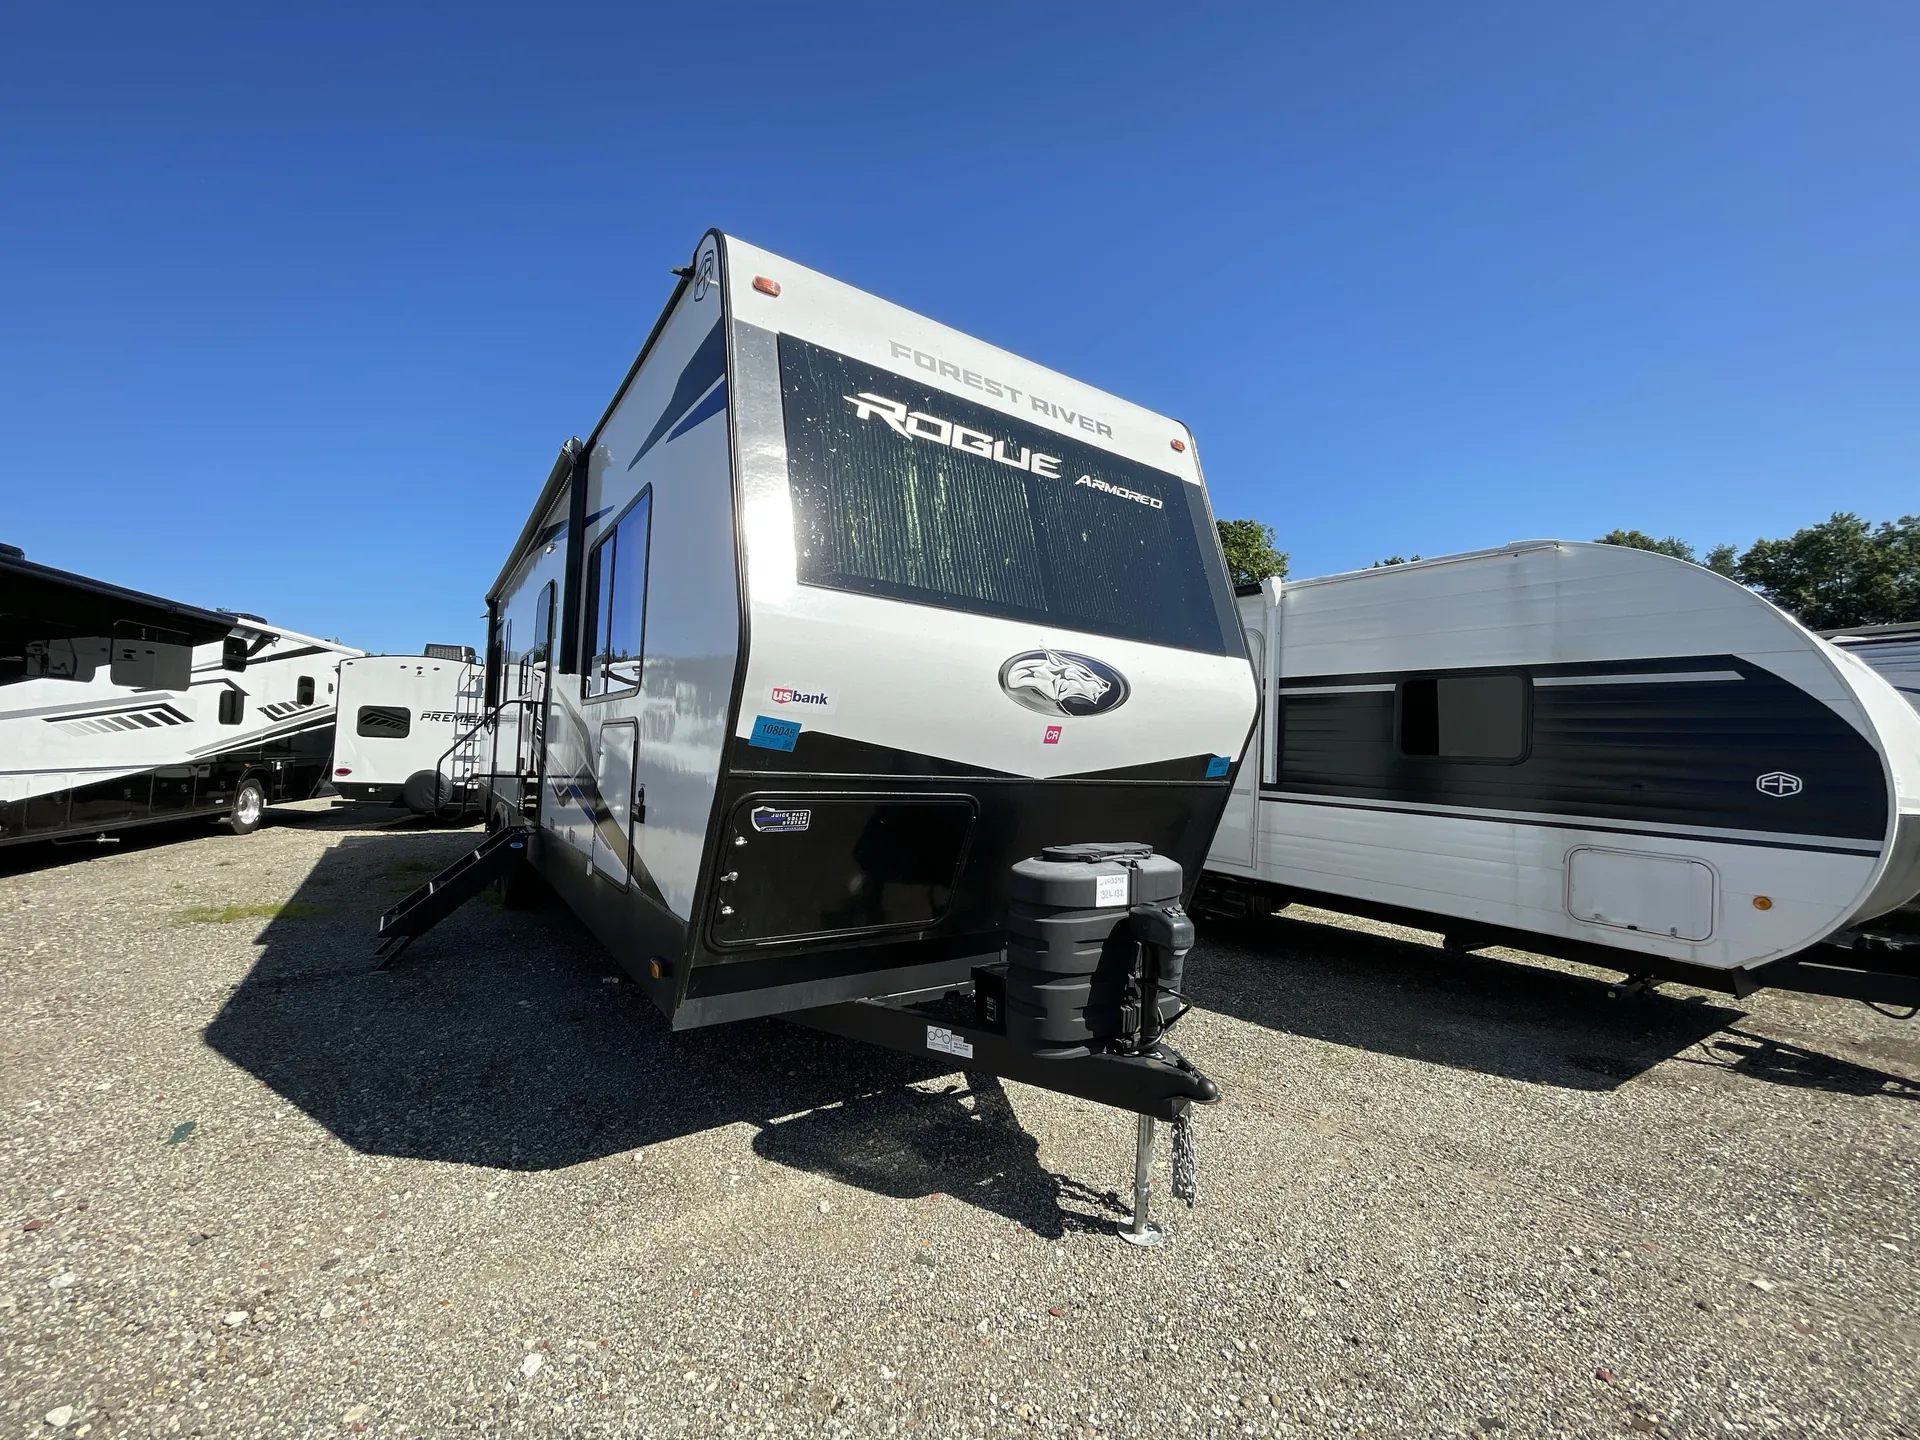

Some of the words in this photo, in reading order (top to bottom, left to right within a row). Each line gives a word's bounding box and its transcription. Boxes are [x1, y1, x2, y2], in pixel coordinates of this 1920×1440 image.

[888, 339, 1023, 404] FOREST
[1028, 394, 1115, 440] RIVER
[842, 392, 1063, 479] ROGUE
[1074, 474, 1164, 510] ARMORED
[762, 723, 798, 738] 108045
[1046, 730, 1060, 740] CR
